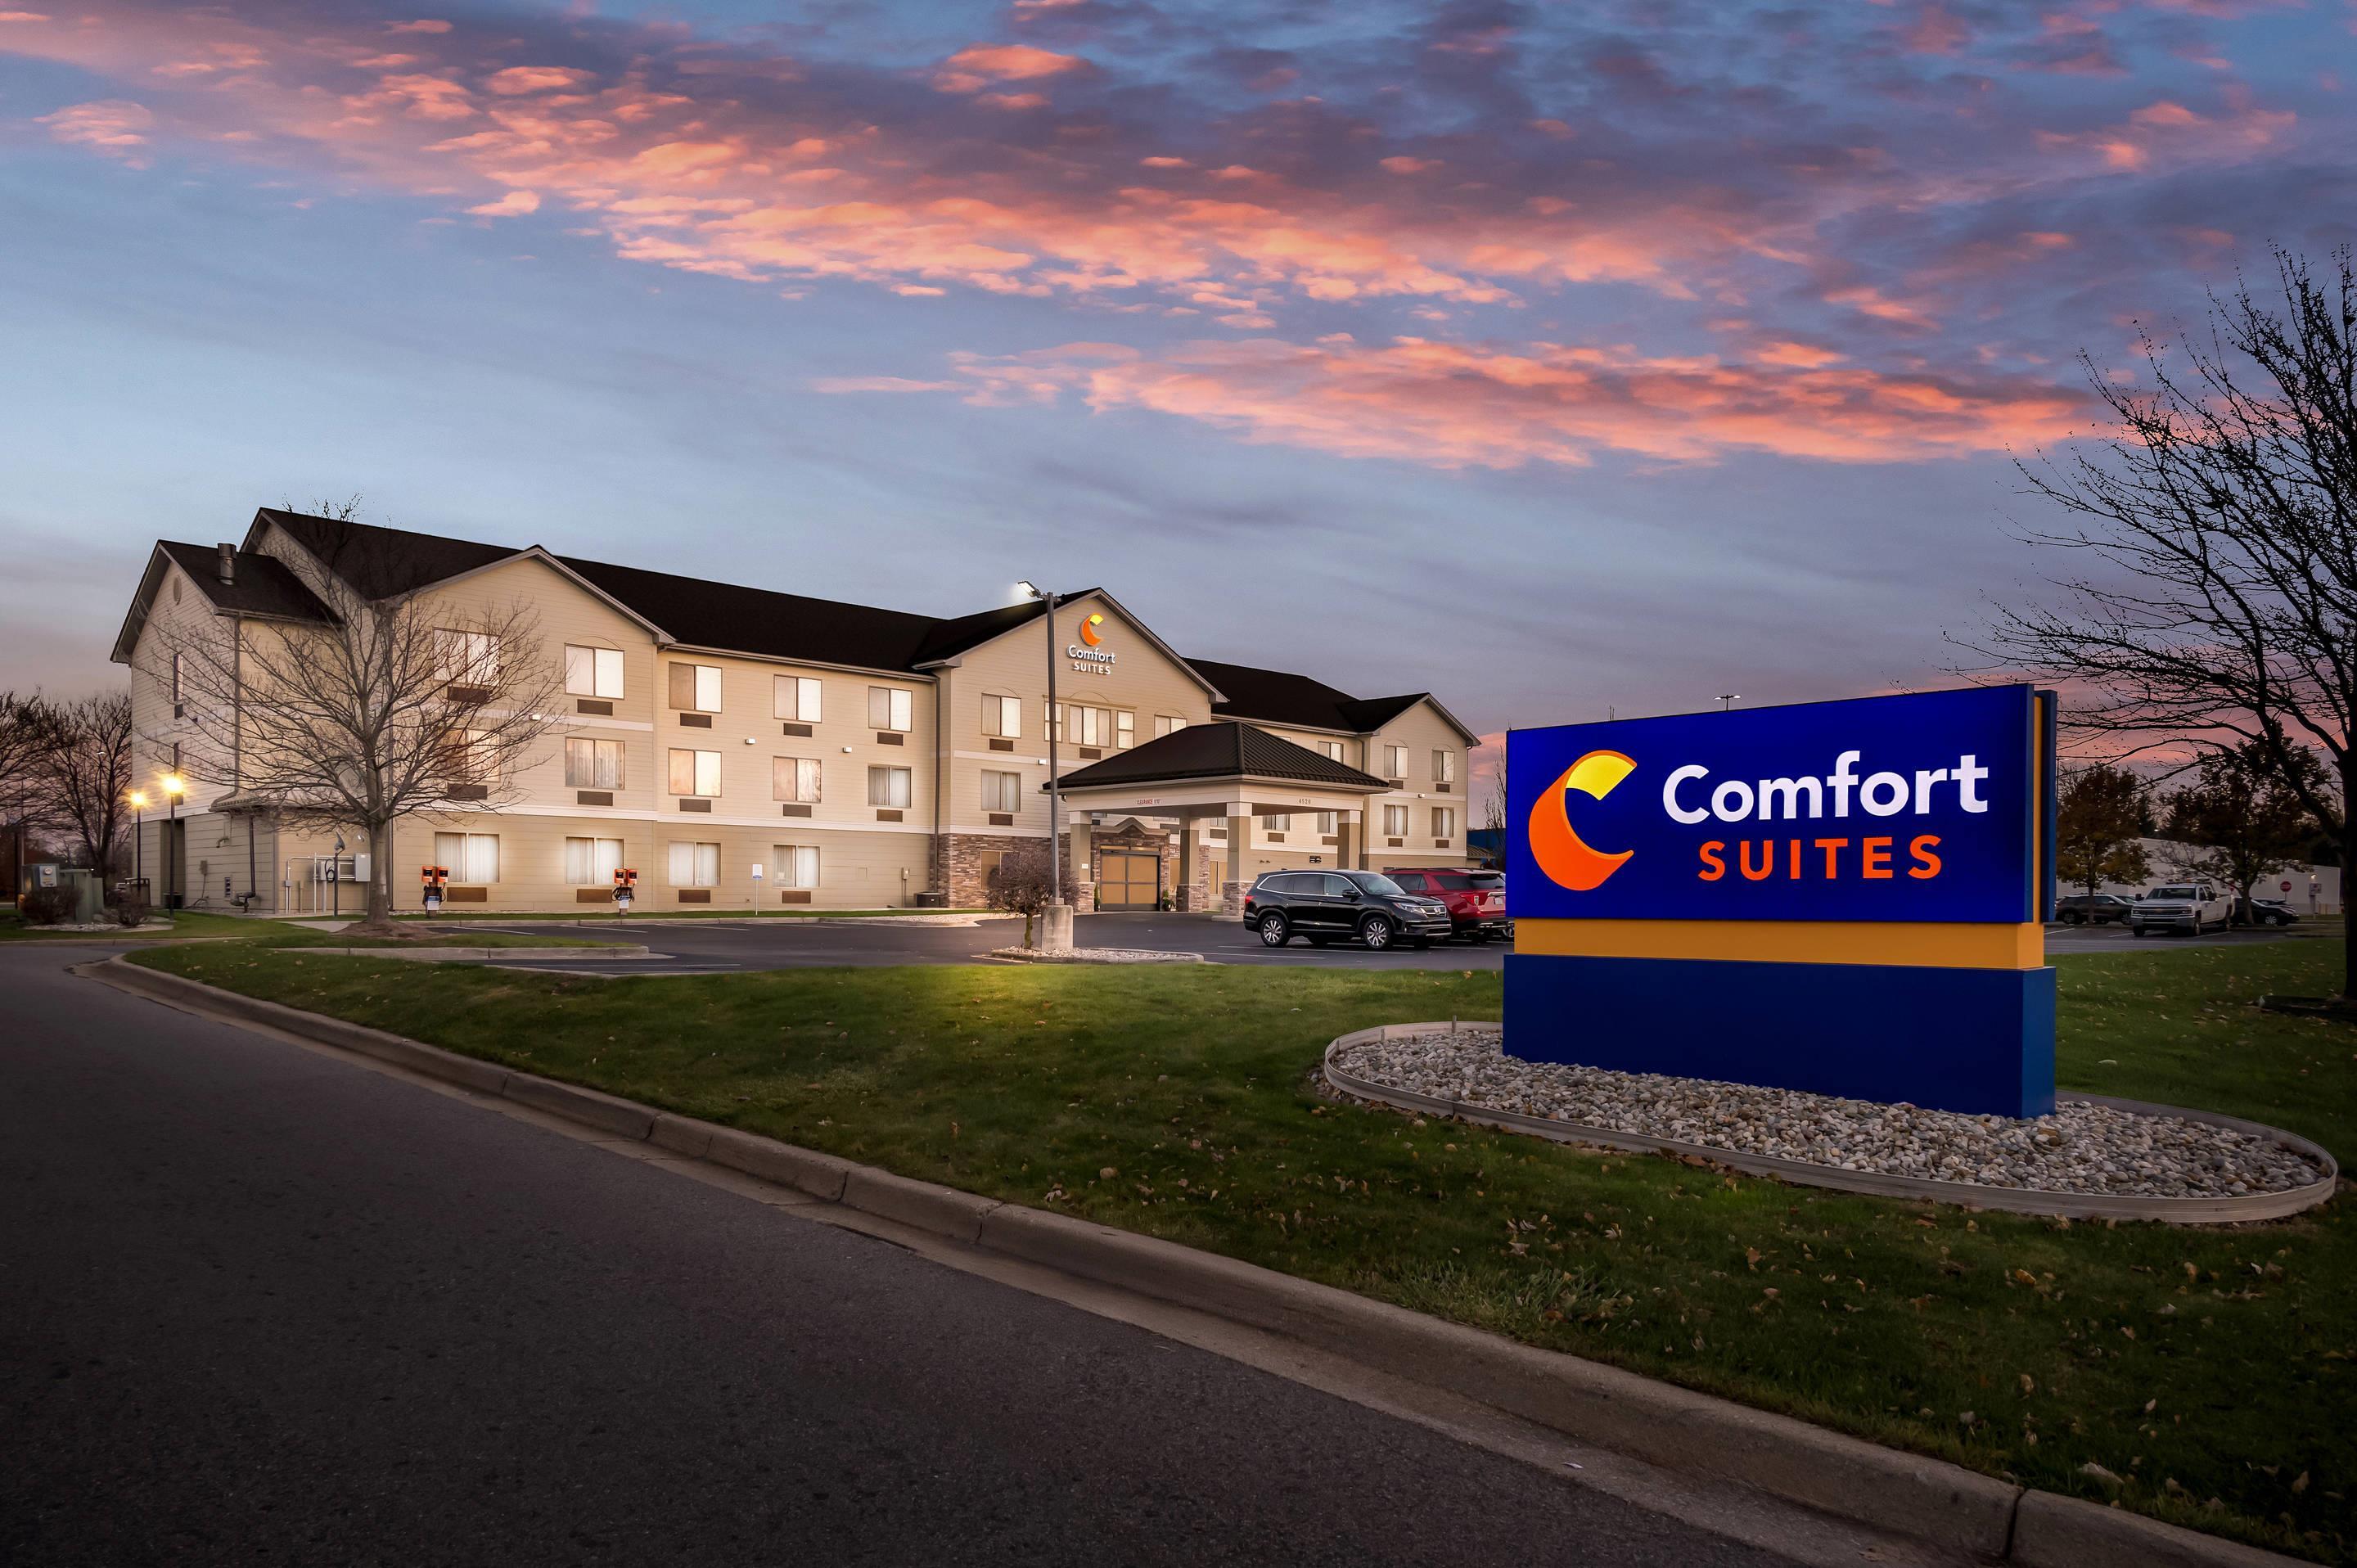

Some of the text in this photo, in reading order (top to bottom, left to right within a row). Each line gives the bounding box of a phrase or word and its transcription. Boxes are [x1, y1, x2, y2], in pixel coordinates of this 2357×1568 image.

[1068, 645, 1115, 664] Comfort
[1073, 661, 1111, 674] SUITES
[1662, 750, 1989, 824] Comfort
[1698, 835, 1942, 881] SUITES
